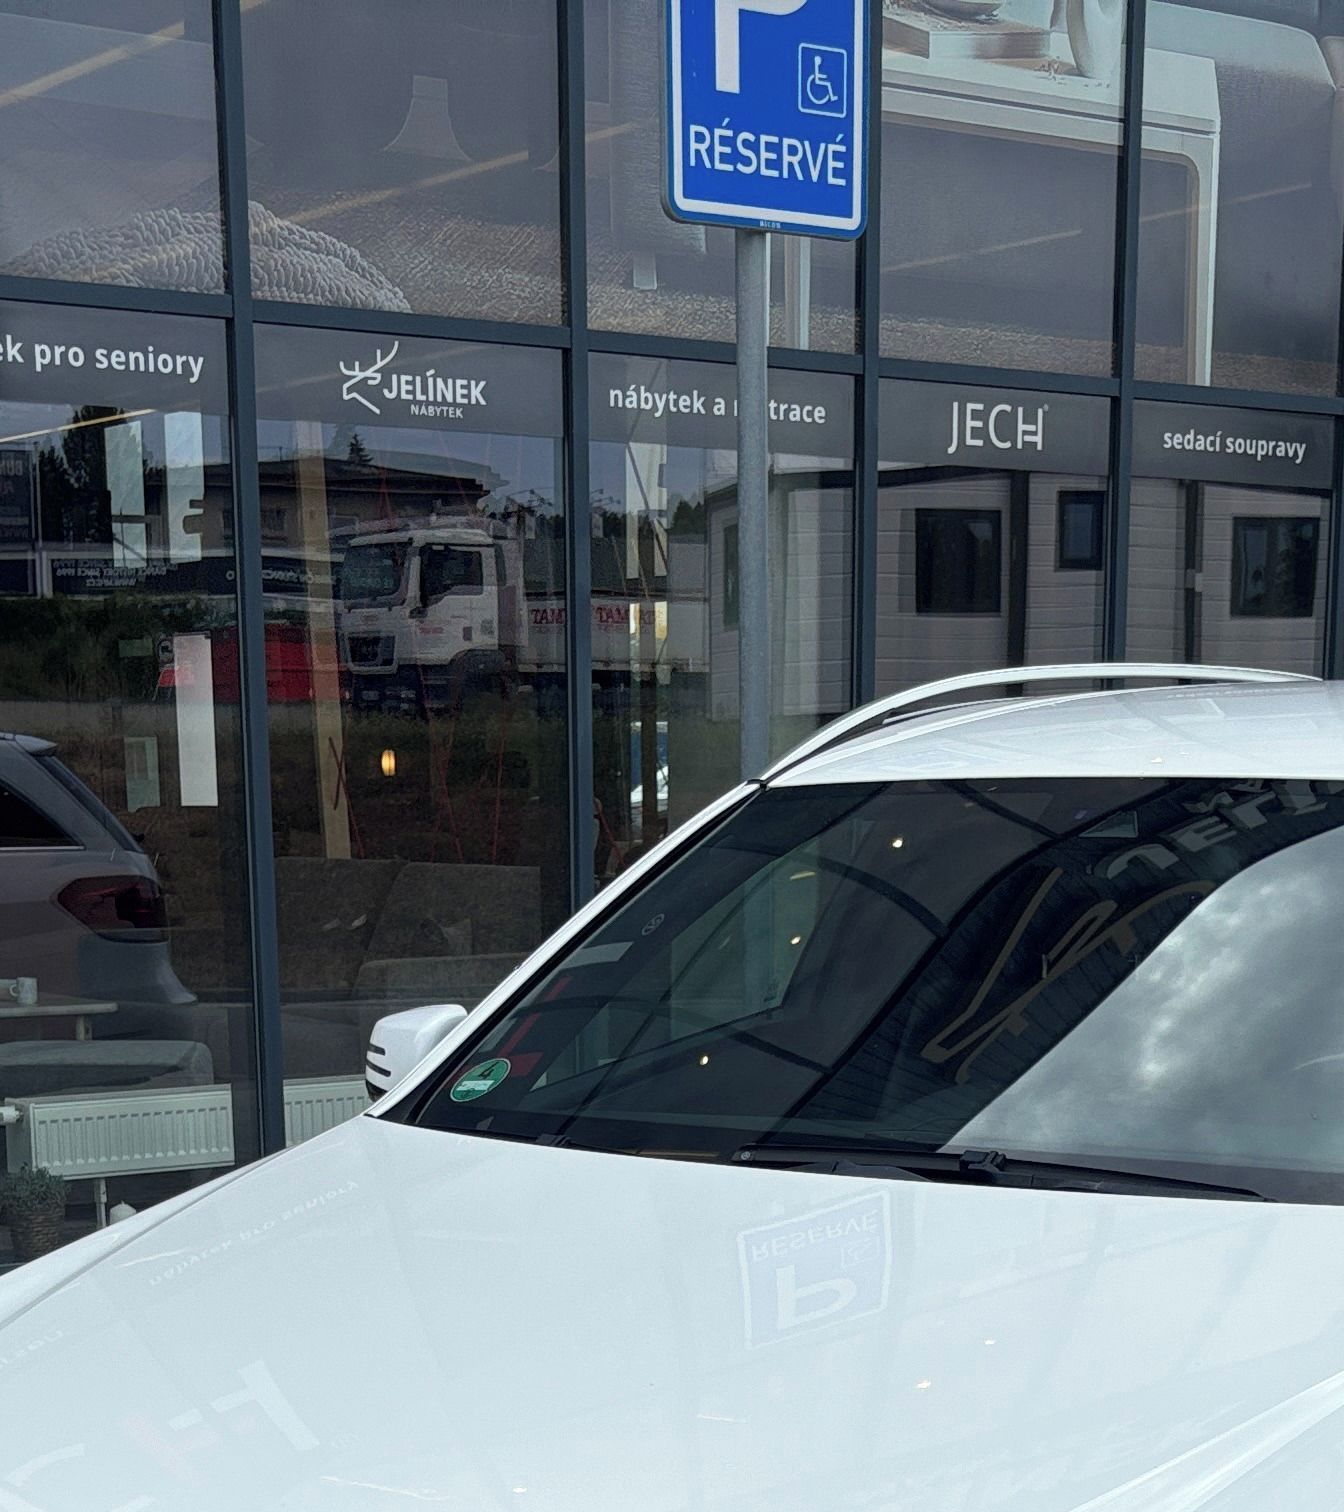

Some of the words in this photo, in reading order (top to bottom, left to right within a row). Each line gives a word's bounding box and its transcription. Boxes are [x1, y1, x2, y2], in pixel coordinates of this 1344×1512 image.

[689, 117, 847, 186] RÉSERVÉ
[34, 342, 85, 372] pro
[94, 345, 204, 383] seniory
[382, 369, 487, 406] JELÍNEK
[608, 384, 706, 417] nábytek
[712, 397, 726, 416] a
[734, 398, 827, 424] trace
[410, 402, 464, 419] NÁBYTEK
[947, 401, 1044, 454] JECH
[1163, 429, 1221, 453] sedací
[1225, 437, 1307, 464] soupravy
